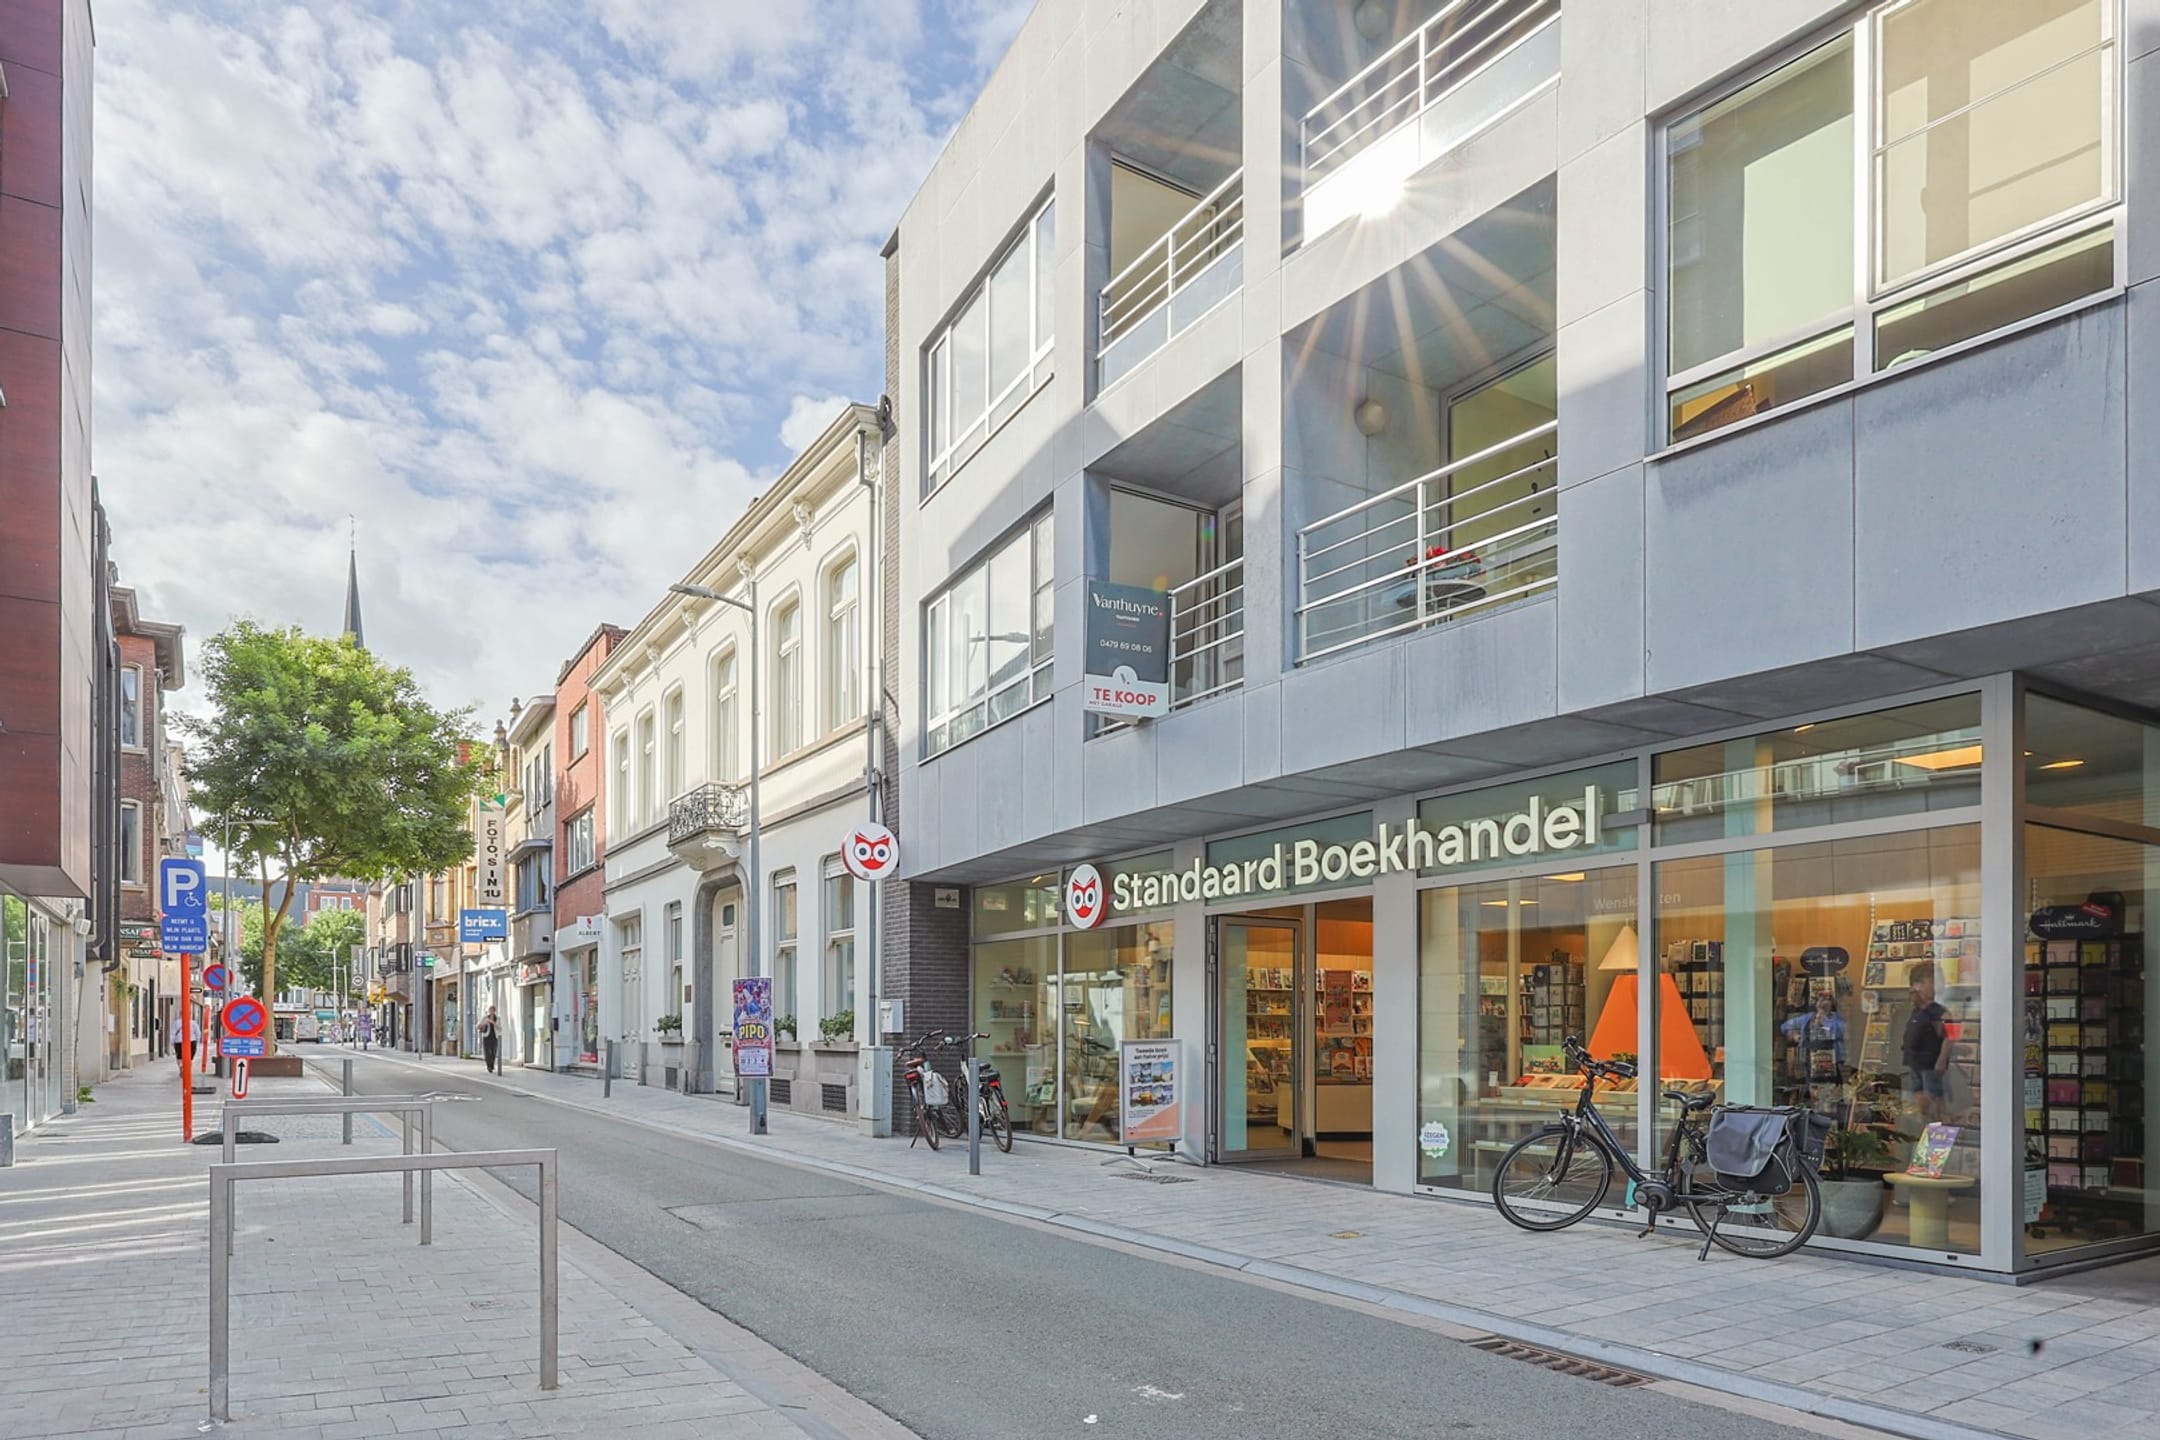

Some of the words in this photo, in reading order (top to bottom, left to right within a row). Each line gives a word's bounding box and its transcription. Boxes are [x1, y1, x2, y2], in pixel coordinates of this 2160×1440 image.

[1093, 687, 1111, 701] TE
[1115, 690, 1157, 706] KOOP
[1112, 844, 1283, 911] Standaard
[1294, 785, 1597, 885] Boekhandel
[167, 868, 200, 907] P
[1592, 892, 1682, 911] Wenskten
[739, 1023, 766, 1040] PIPO
